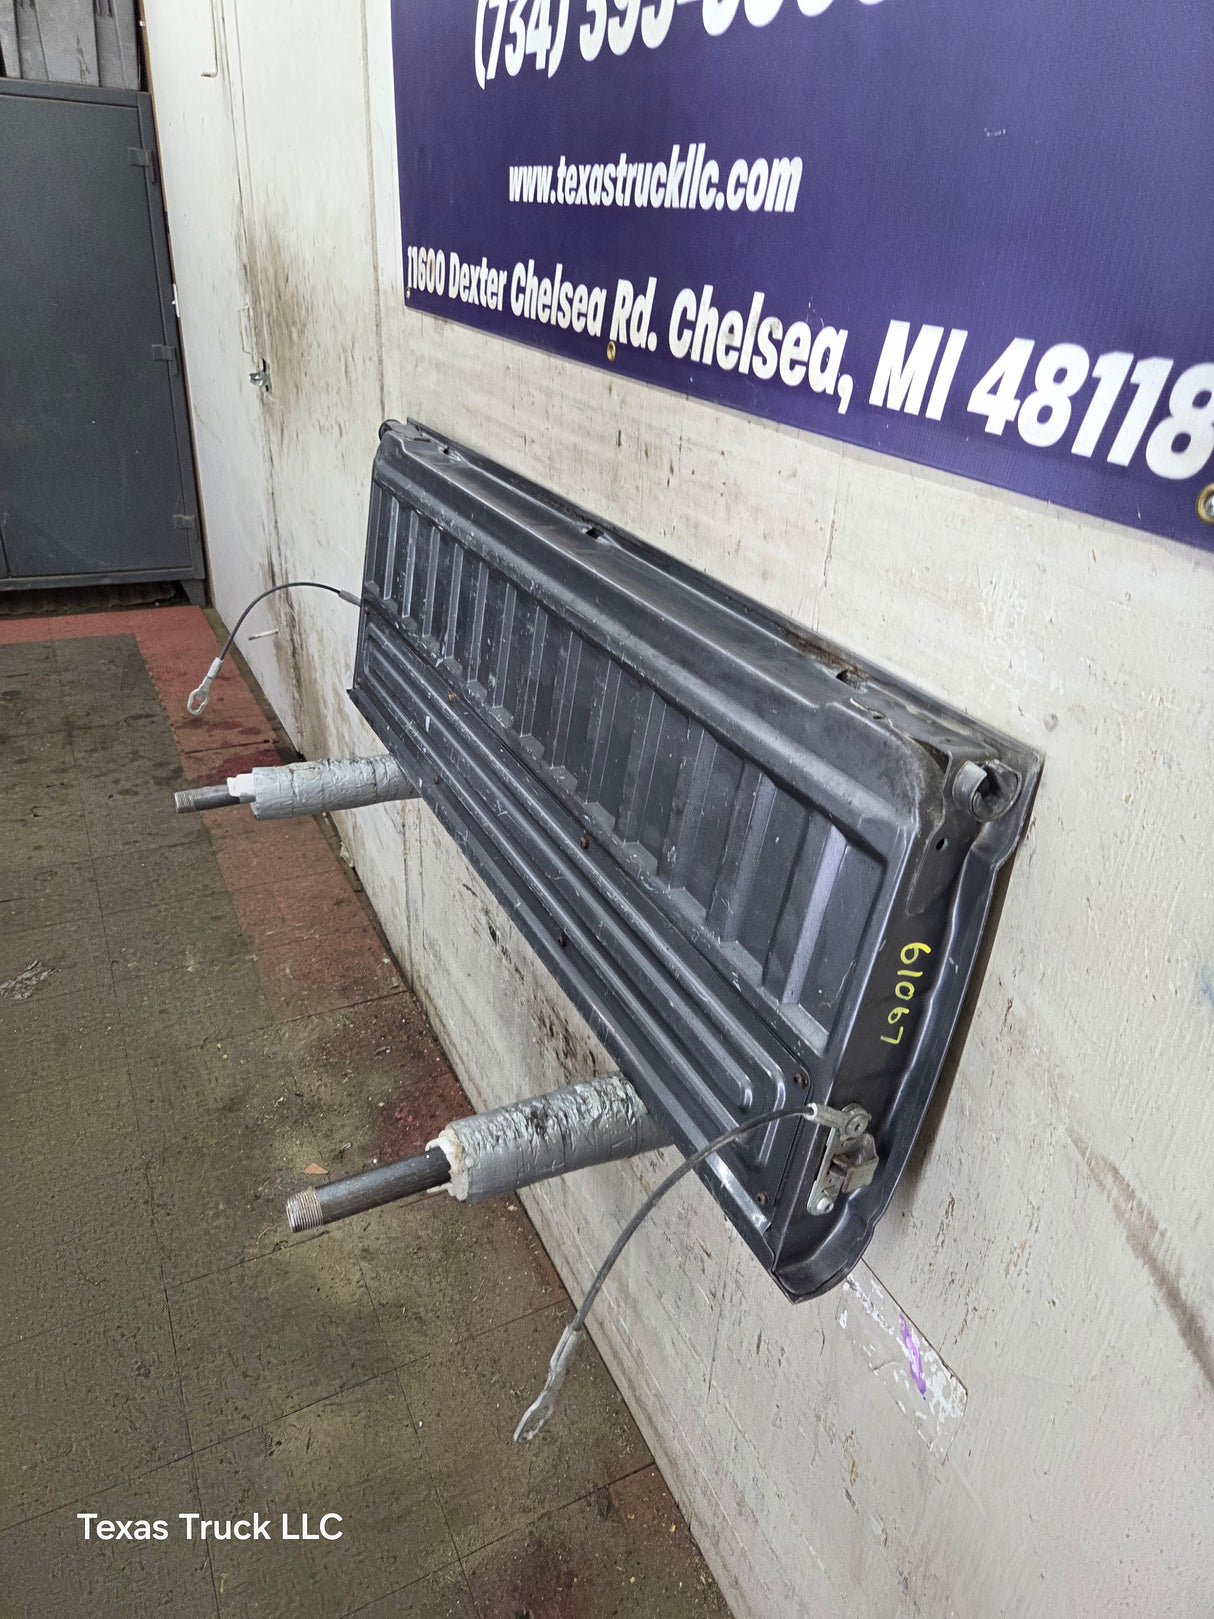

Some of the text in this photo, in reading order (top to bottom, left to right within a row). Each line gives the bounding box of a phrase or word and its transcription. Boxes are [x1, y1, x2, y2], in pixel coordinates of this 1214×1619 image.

[475, 0, 569, 89] (734)
[508, 142, 803, 213] www.texastruckllc.com
[407, 246, 1214, 480] 11600 Dexter Chelsea Rd. Chelsea, MI 48118
[880, 942, 932, 1045] 61067
